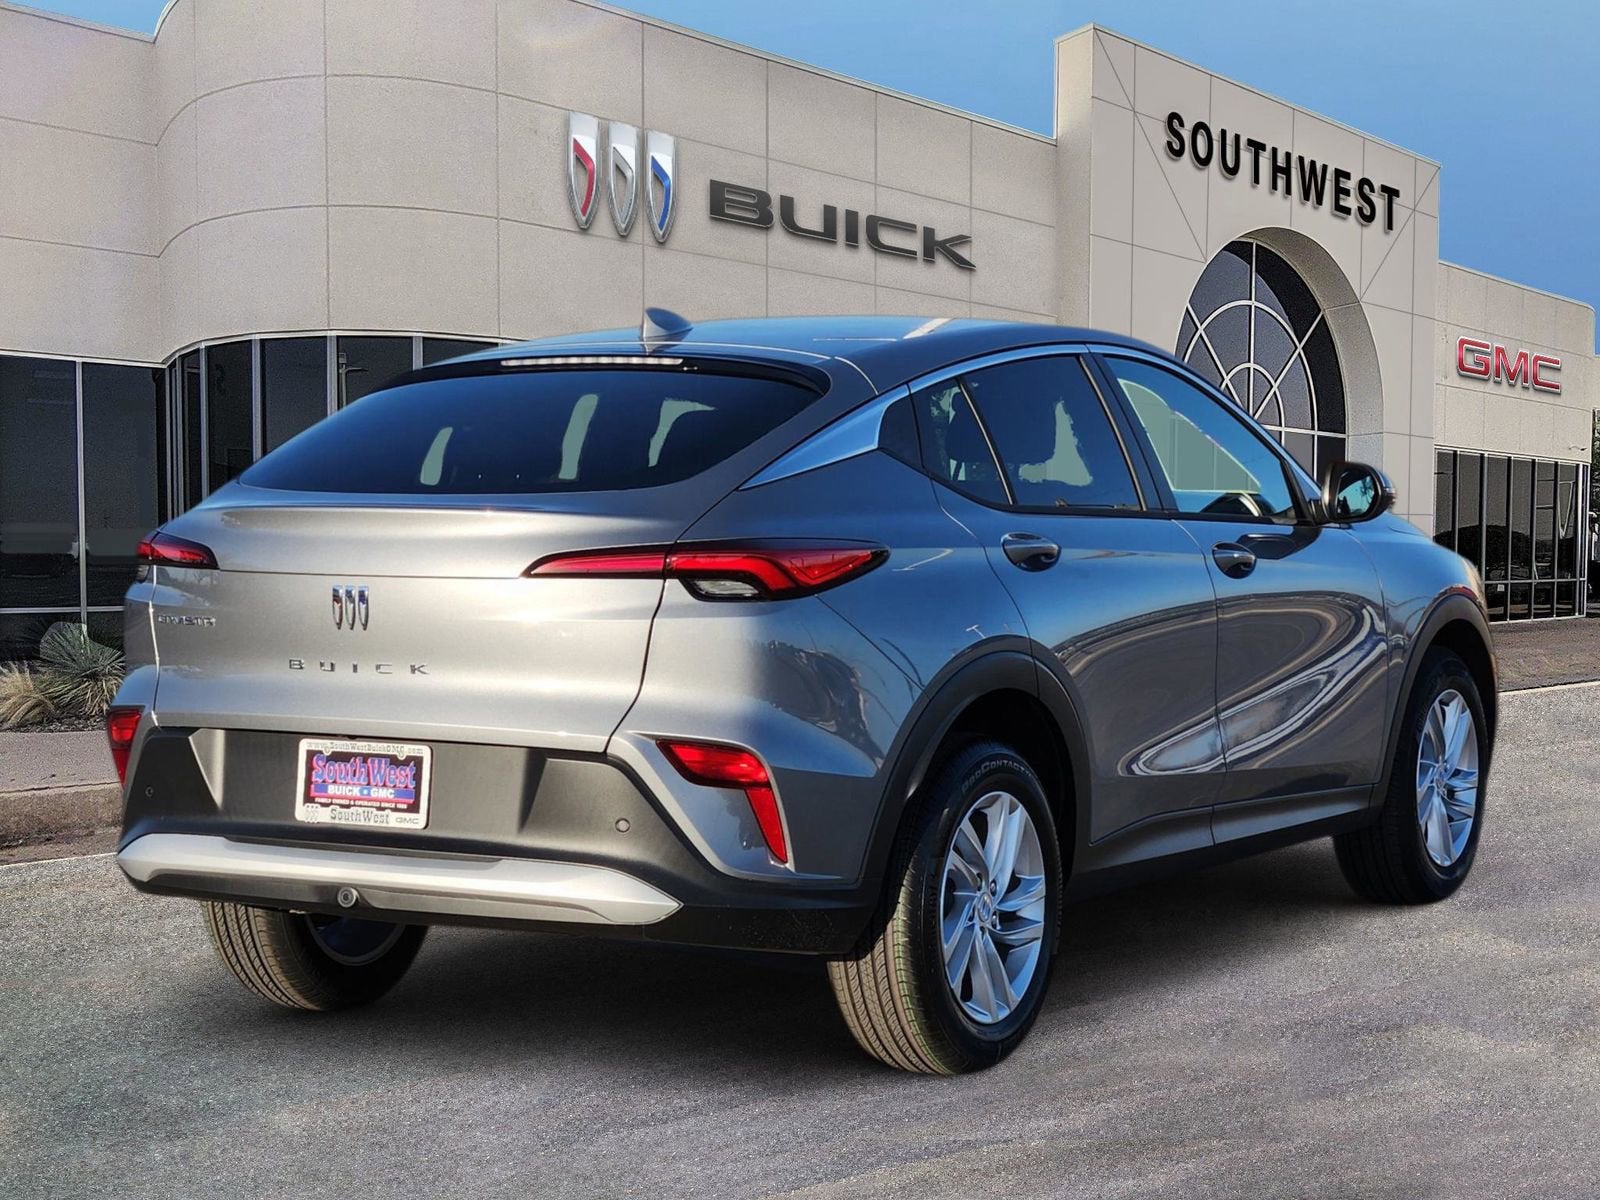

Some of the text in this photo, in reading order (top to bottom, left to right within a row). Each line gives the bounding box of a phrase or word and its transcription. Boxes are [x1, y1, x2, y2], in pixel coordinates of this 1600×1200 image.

[1165, 111, 1400, 231] SOUTHWEST
[709, 179, 976, 270] BUICK
[1457, 335, 1562, 394] GMC
[288, 658, 430, 675] BUICK
[327, 784, 395, 798] BUICK GMC
[395, 816, 420, 825] GMC
